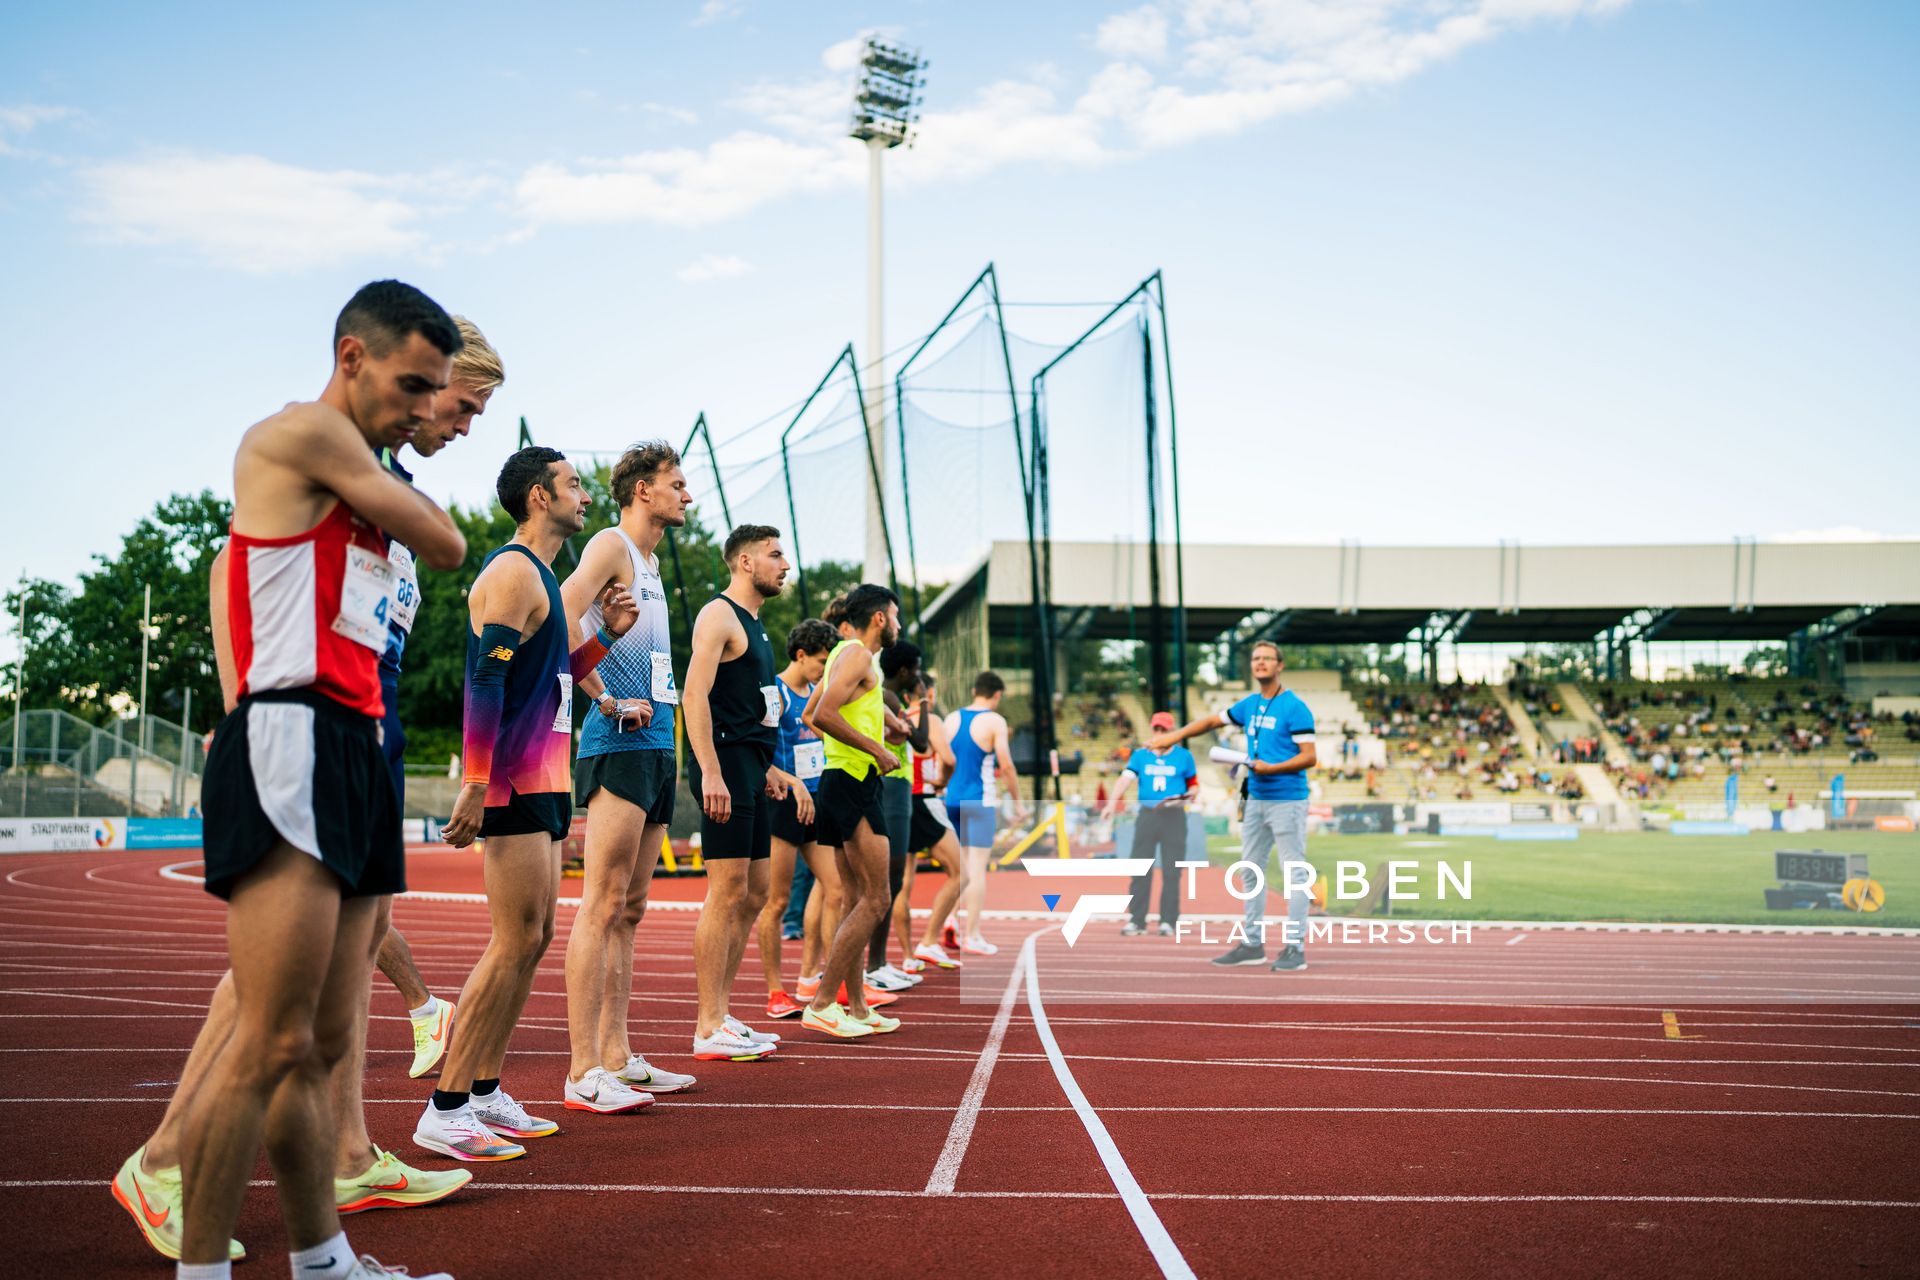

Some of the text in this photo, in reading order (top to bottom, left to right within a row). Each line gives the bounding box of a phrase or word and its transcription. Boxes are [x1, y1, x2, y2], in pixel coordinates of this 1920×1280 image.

[397, 577, 414, 608] 86
[373, 596, 388, 625] 4
[653, 656, 671, 666] VIACT
[667, 672, 674, 690] 2
[811, 756, 817, 768] 9
[31, 822, 90, 836] STADTWERKE
[485, 1110, 520, 1128] balance
